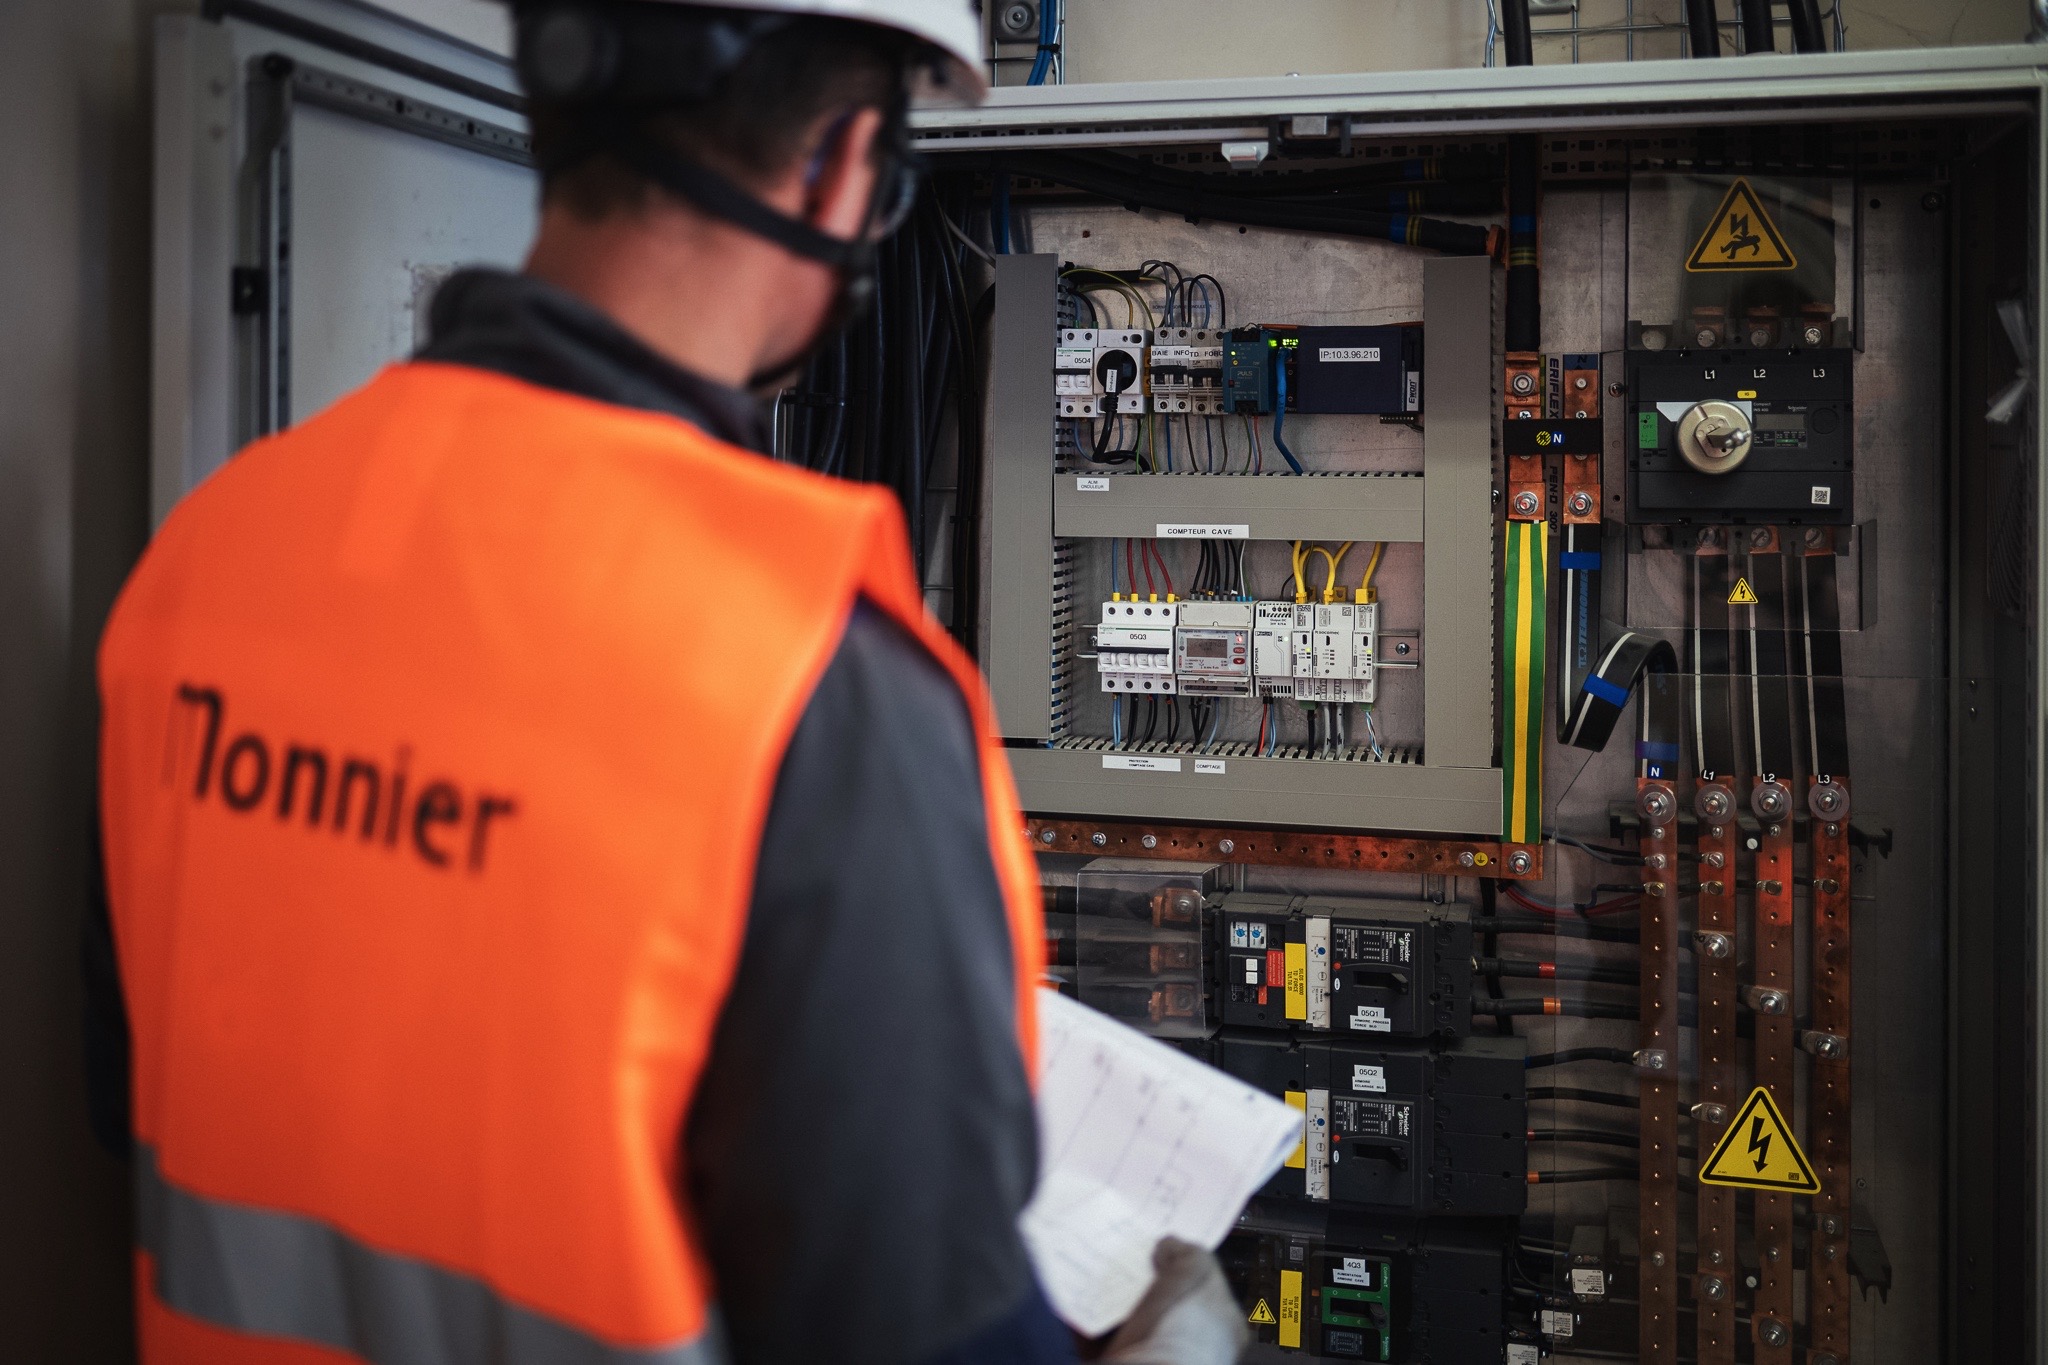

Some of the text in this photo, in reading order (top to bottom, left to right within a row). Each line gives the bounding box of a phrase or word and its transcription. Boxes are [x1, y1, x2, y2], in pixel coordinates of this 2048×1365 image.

[1320, 350, 1379, 359] IP:10.3.96.210
[1704, 370, 1716, 379] L1
[1753, 369, 1766, 378] L2
[1812, 368, 1826, 378] L3
[1550, 357, 1559, 418] ERIFLEX
[1553, 433, 1562, 443] N
[1650, 767, 1660, 776] N
[1703, 770, 1715, 780] L1
[1762, 773, 1775, 783] L2
[1817, 775, 1830, 784] L3
[1361, 1009, 1379, 1017] 05Q1
[1359, 1068, 1377, 1076] 05Q2
[1347, 1261, 1361, 1269] 4Q3
